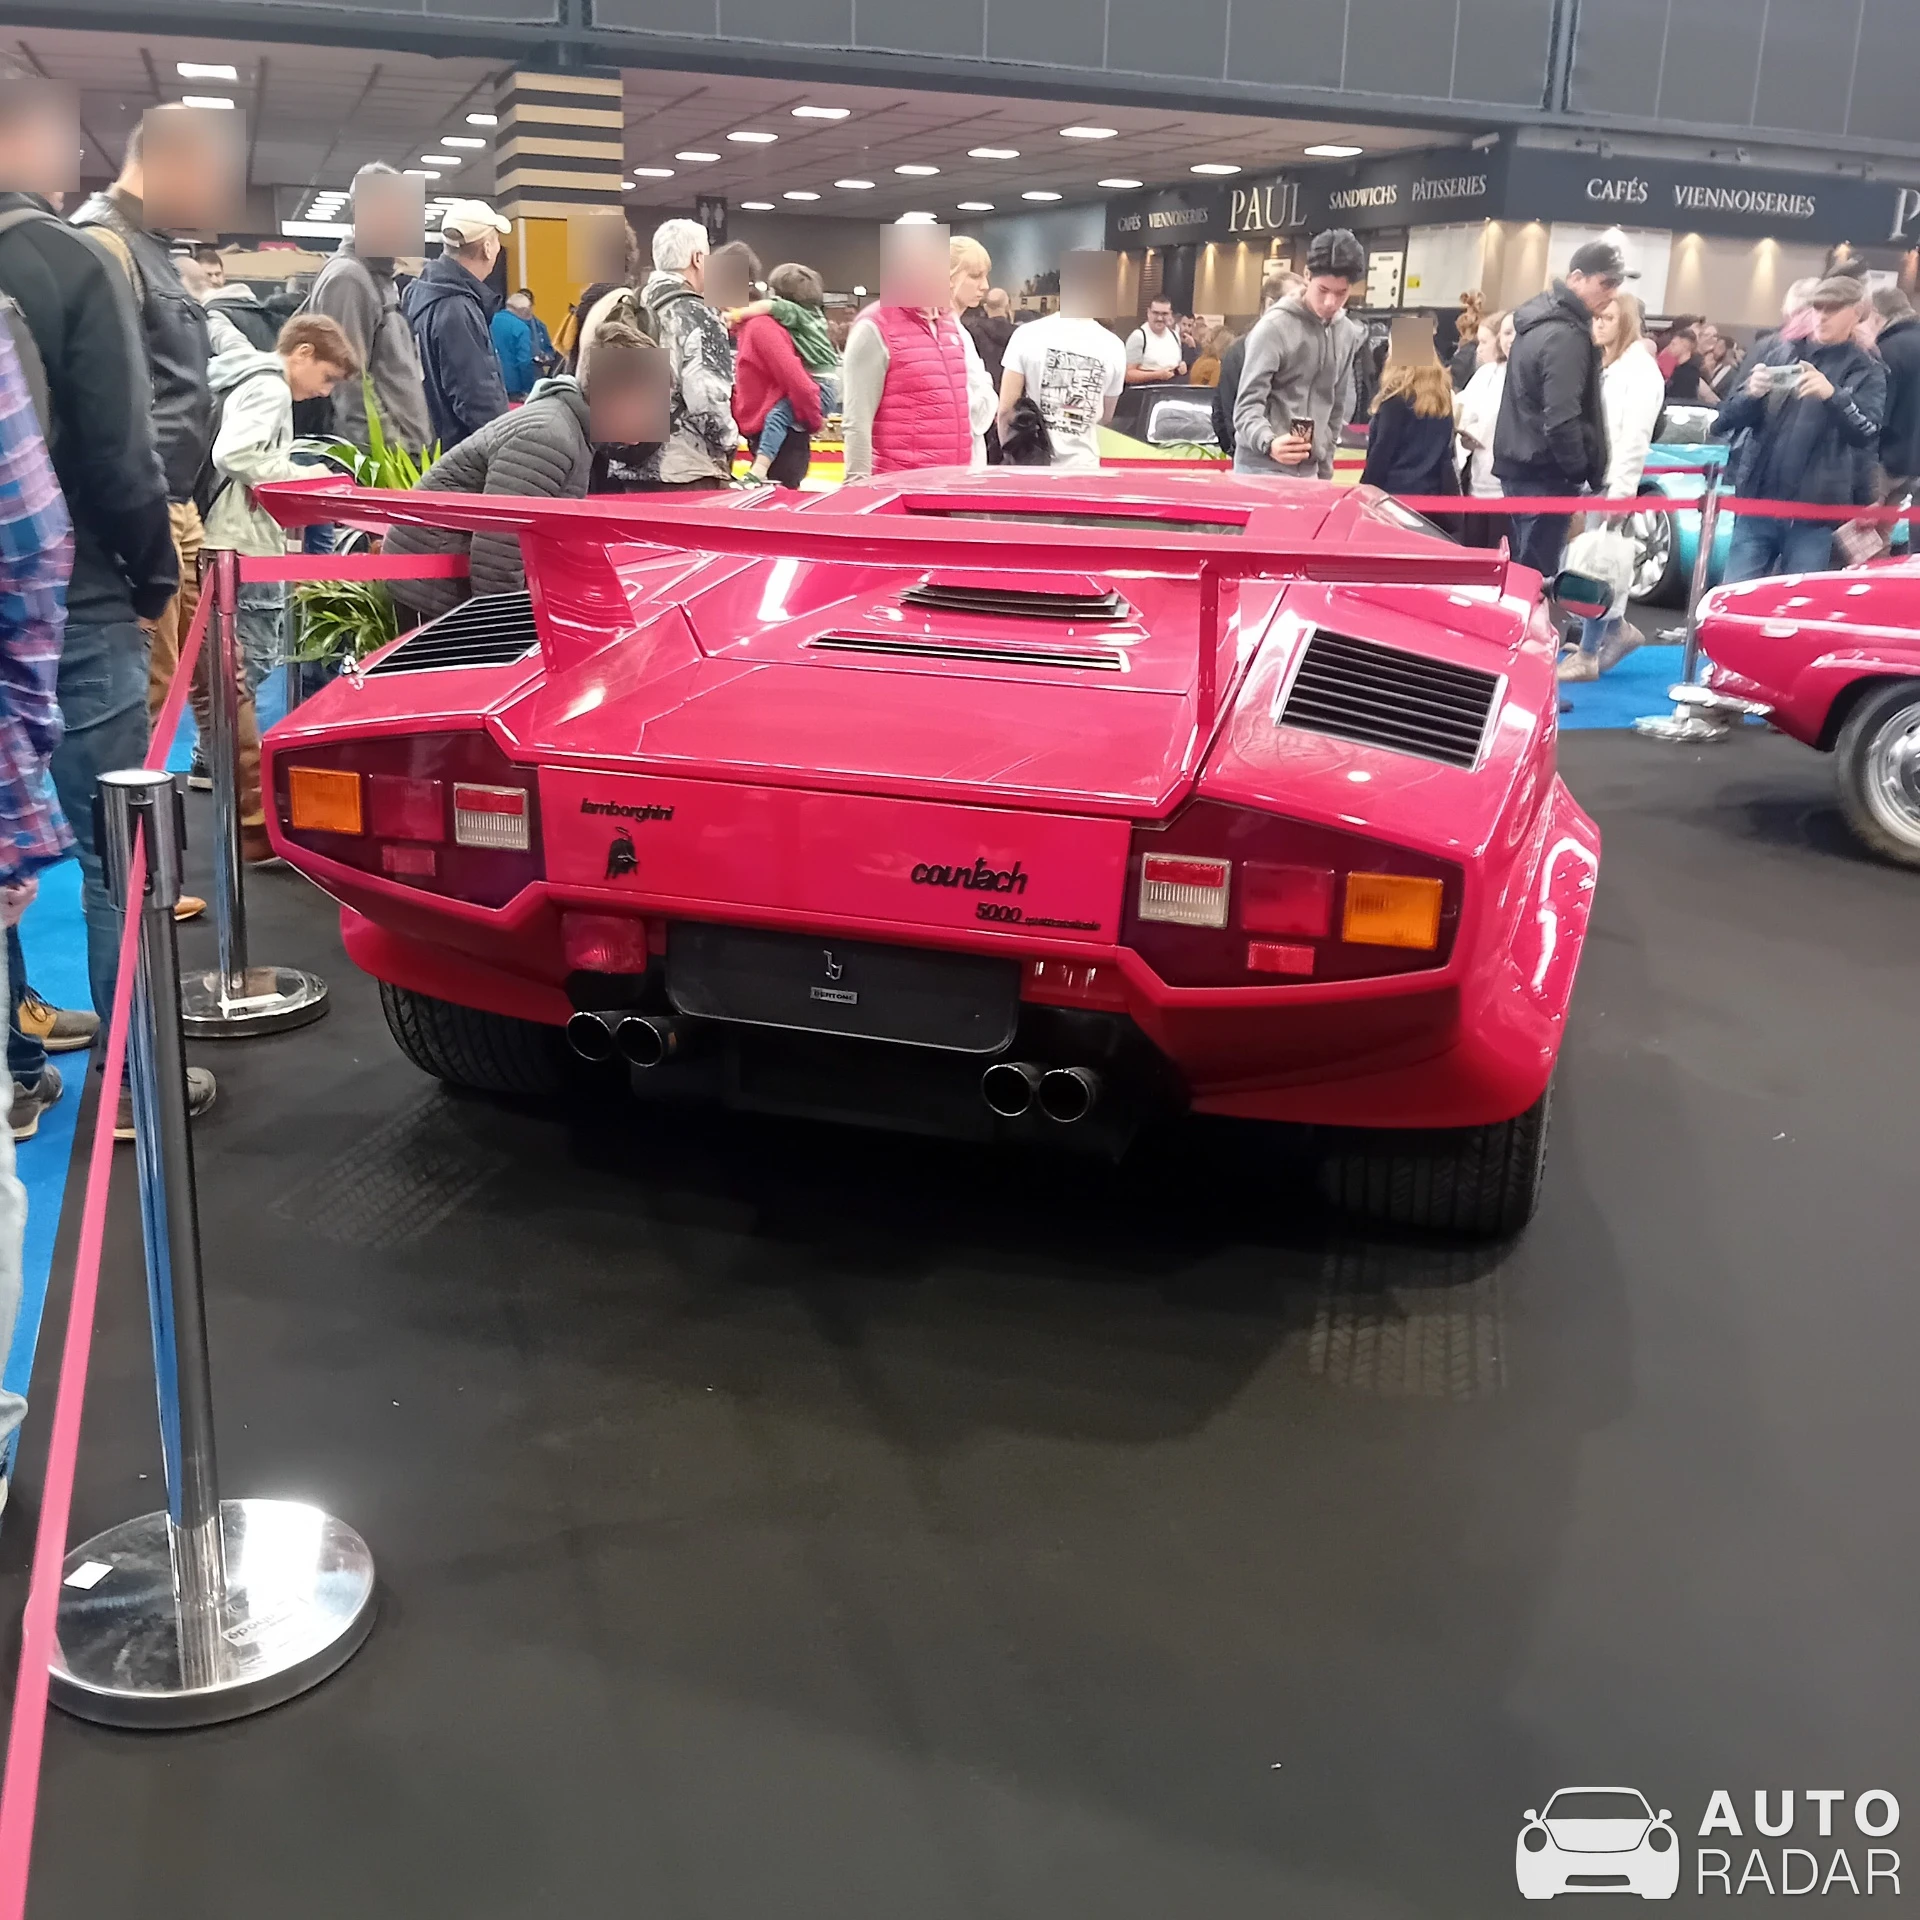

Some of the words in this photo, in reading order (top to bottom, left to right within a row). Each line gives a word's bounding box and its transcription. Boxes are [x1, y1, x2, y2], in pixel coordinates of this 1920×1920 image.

[1227, 182, 1308, 232] PAUL
[1328, 184, 1398, 209] SANDWICHS
[1411, 175, 1488, 201] PÂTISSERIES
[1587, 177, 1649, 204] CAFÉS
[1674, 185, 1816, 218] VIENNOISERIES
[581, 798, 675, 823] lamborghini
[911, 857, 1028, 895] countach
[975, 901, 1023, 921] 5000
